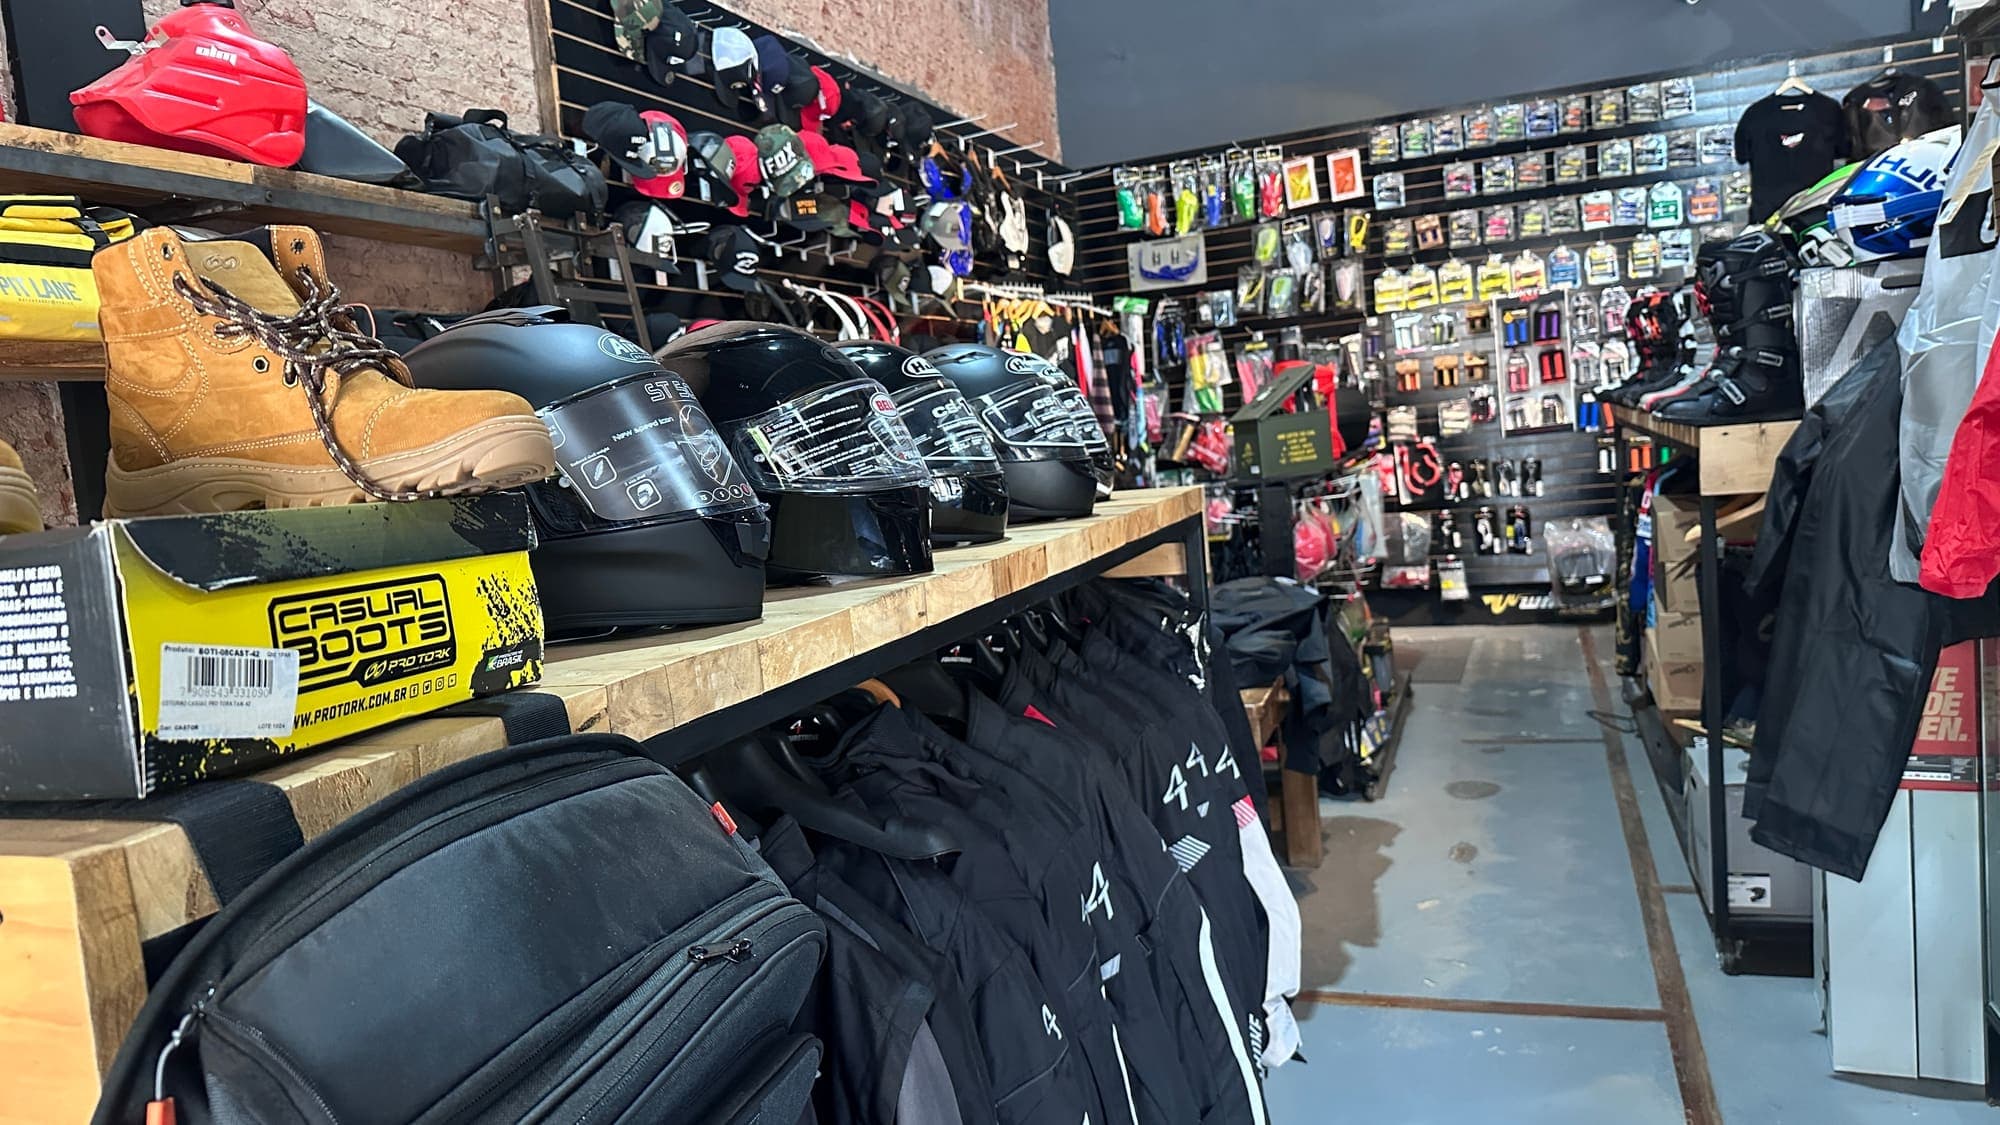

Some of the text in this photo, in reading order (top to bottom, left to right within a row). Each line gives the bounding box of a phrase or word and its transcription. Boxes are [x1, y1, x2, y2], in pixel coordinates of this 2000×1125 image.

[765, 141, 796, 174] FOX
[28, 278, 82, 301] LANE
[645, 381, 672, 401] ST
[278, 587, 442, 634] CASUAL
[283, 610, 447, 666] BOOTS
[388, 655, 416, 671] PRO
[417, 647, 451, 664] TORK
[496, 654, 523, 669] BRASIL
